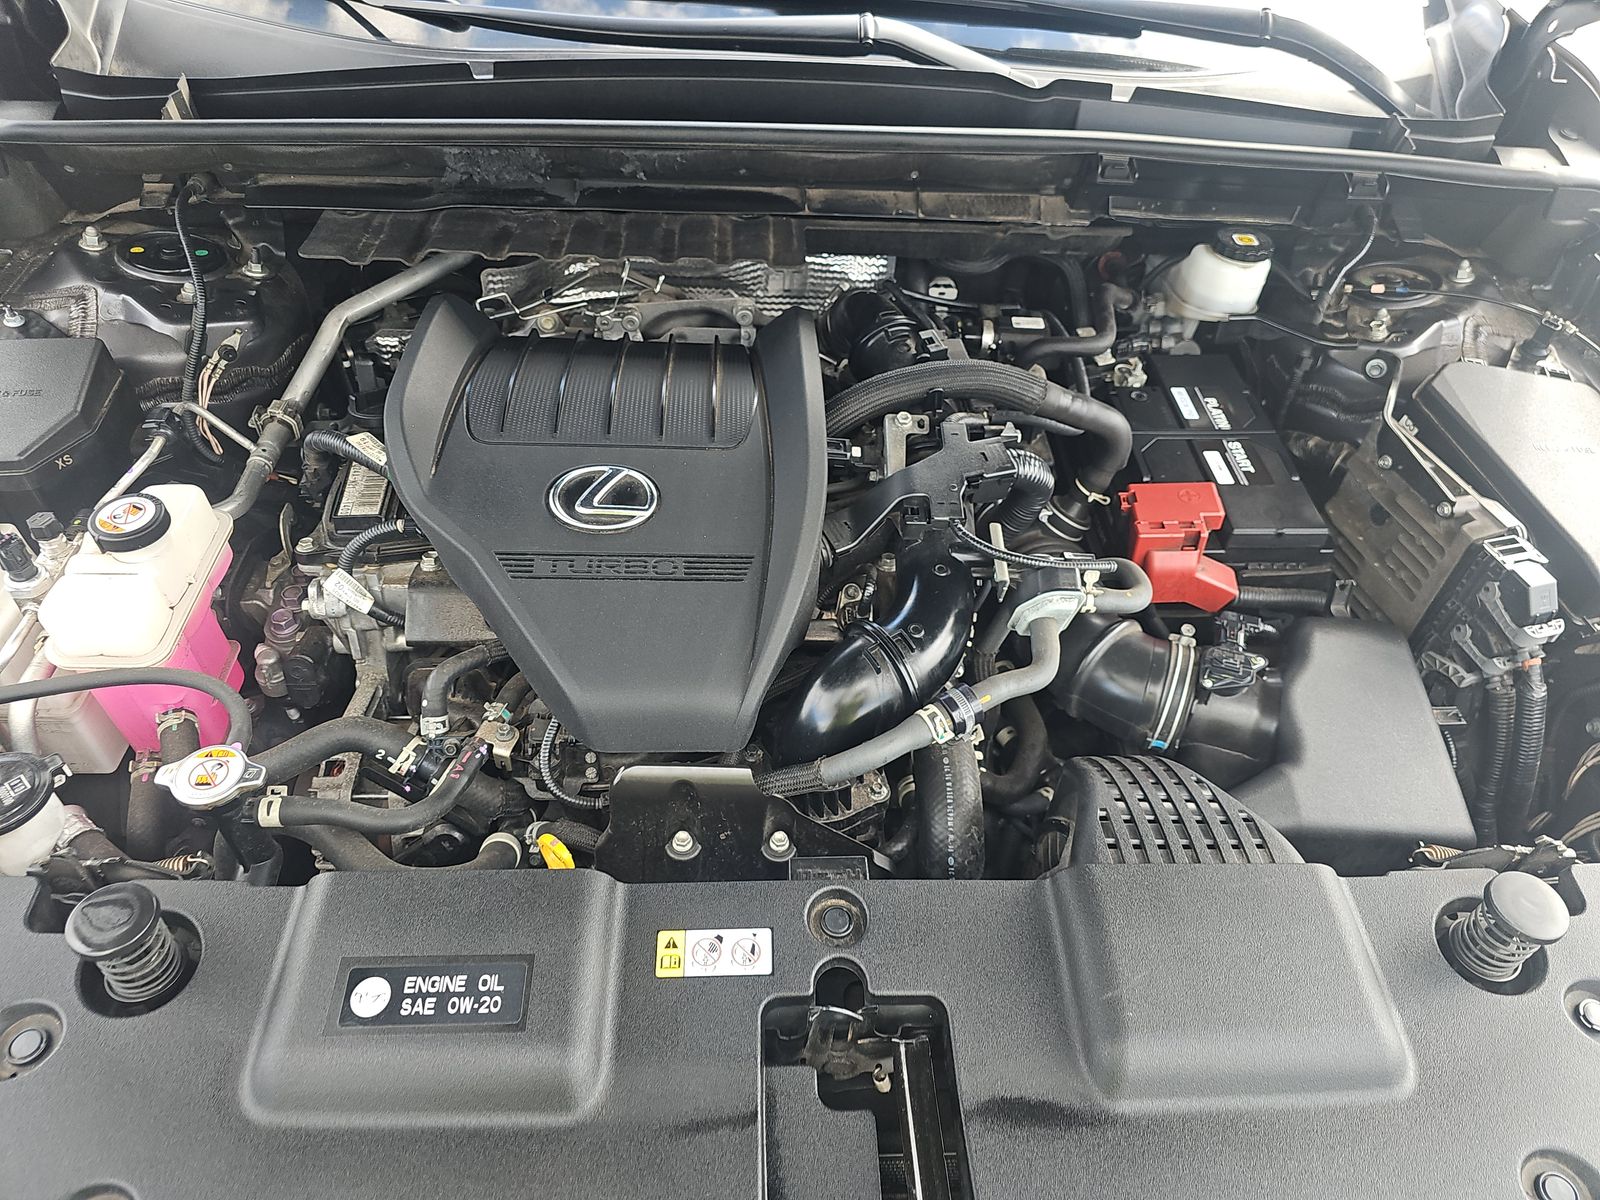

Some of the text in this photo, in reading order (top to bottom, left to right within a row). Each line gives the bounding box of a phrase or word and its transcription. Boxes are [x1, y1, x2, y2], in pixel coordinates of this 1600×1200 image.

[1227, 441, 1256, 474] START
[540, 557, 681, 577] TURBO
[403, 973, 505, 993] ENGINE OIL
[400, 995, 502, 1016] SAE 0W-20
